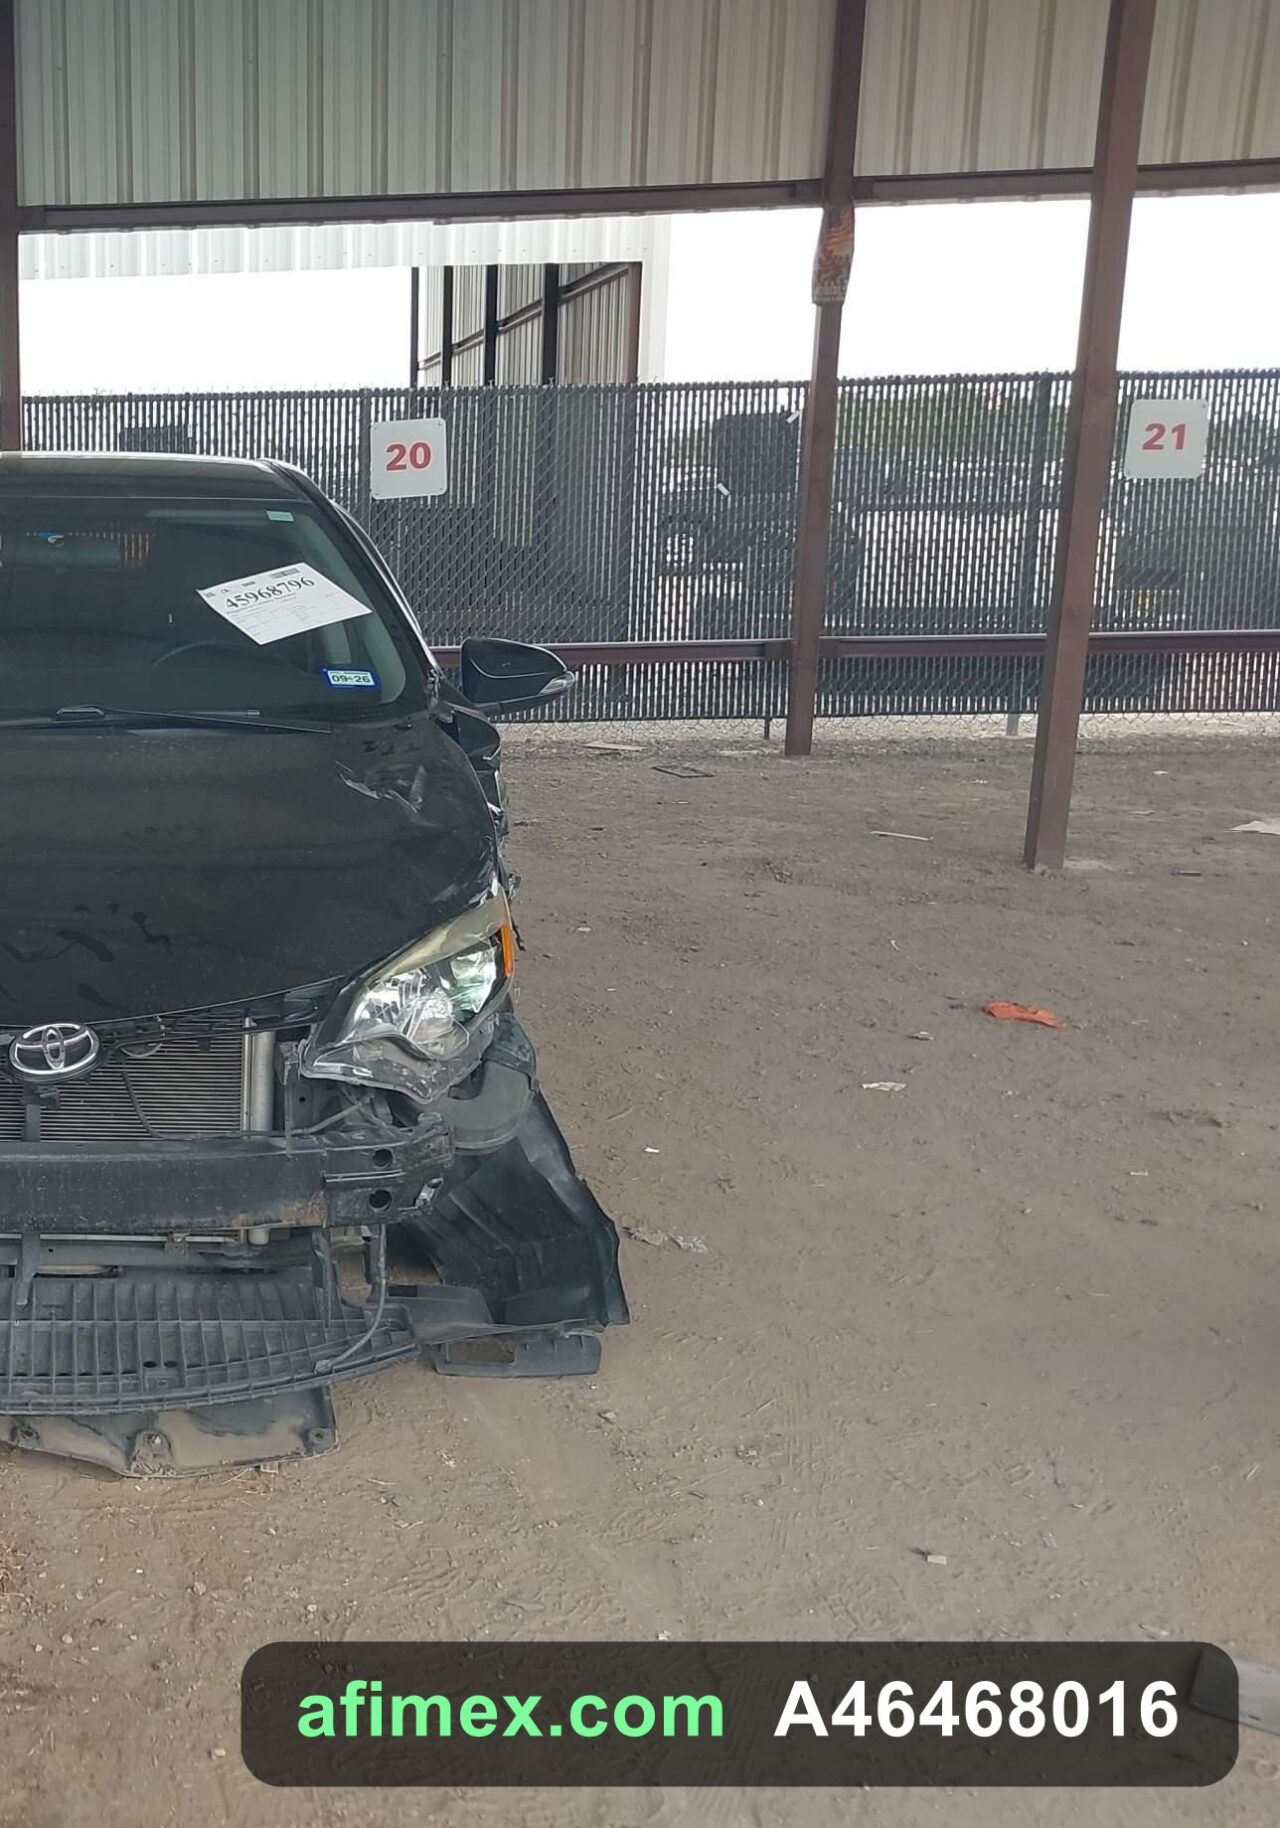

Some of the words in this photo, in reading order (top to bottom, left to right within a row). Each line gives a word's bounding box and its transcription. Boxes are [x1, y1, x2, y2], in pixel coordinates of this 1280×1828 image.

[1142, 424, 1186, 450] 21
[387, 443, 432, 471] 20
[225, 576, 316, 608] 45968796
